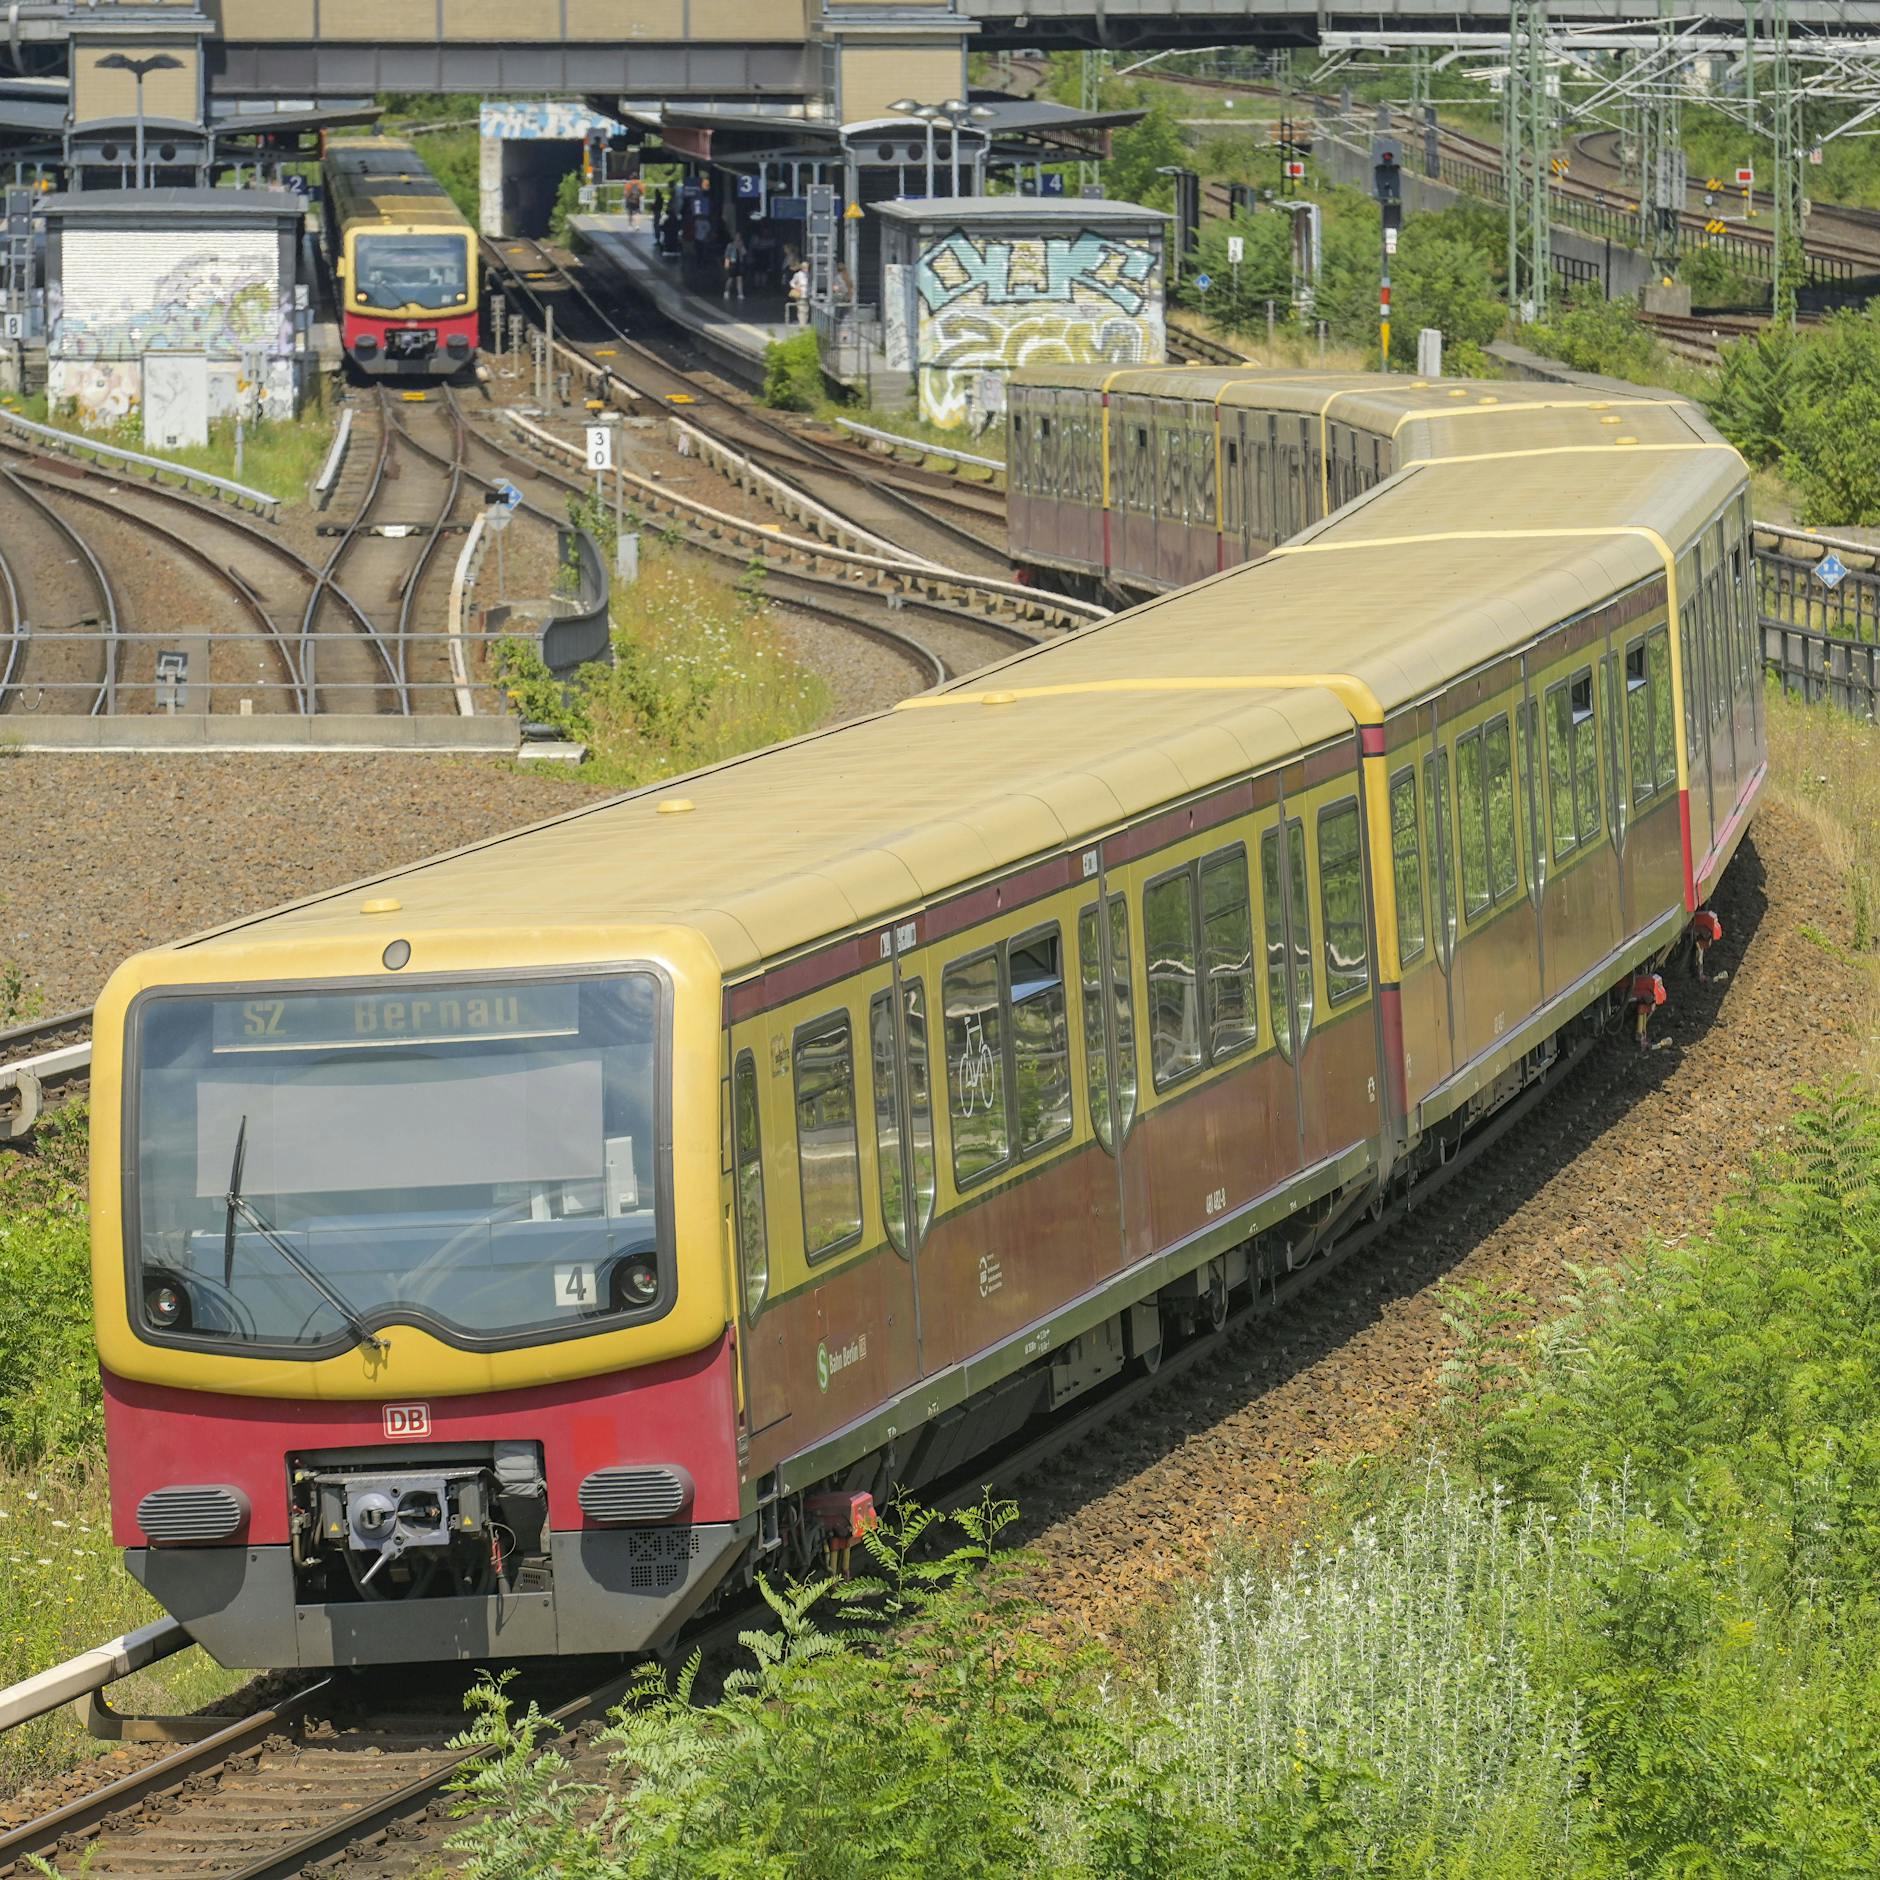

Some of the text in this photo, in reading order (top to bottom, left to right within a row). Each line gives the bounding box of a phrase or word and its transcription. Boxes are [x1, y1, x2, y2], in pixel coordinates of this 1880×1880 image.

[290, 175, 302, 192] 2
[740, 175, 753, 193] 3
[1049, 173, 1062, 191] 4
[595, 431, 604, 446] 3
[595, 450, 604, 465] 0
[242, 994, 520, 1036] S2 Bernau
[565, 1265, 587, 1301] 4
[388, 1408, 427, 1433] DB
